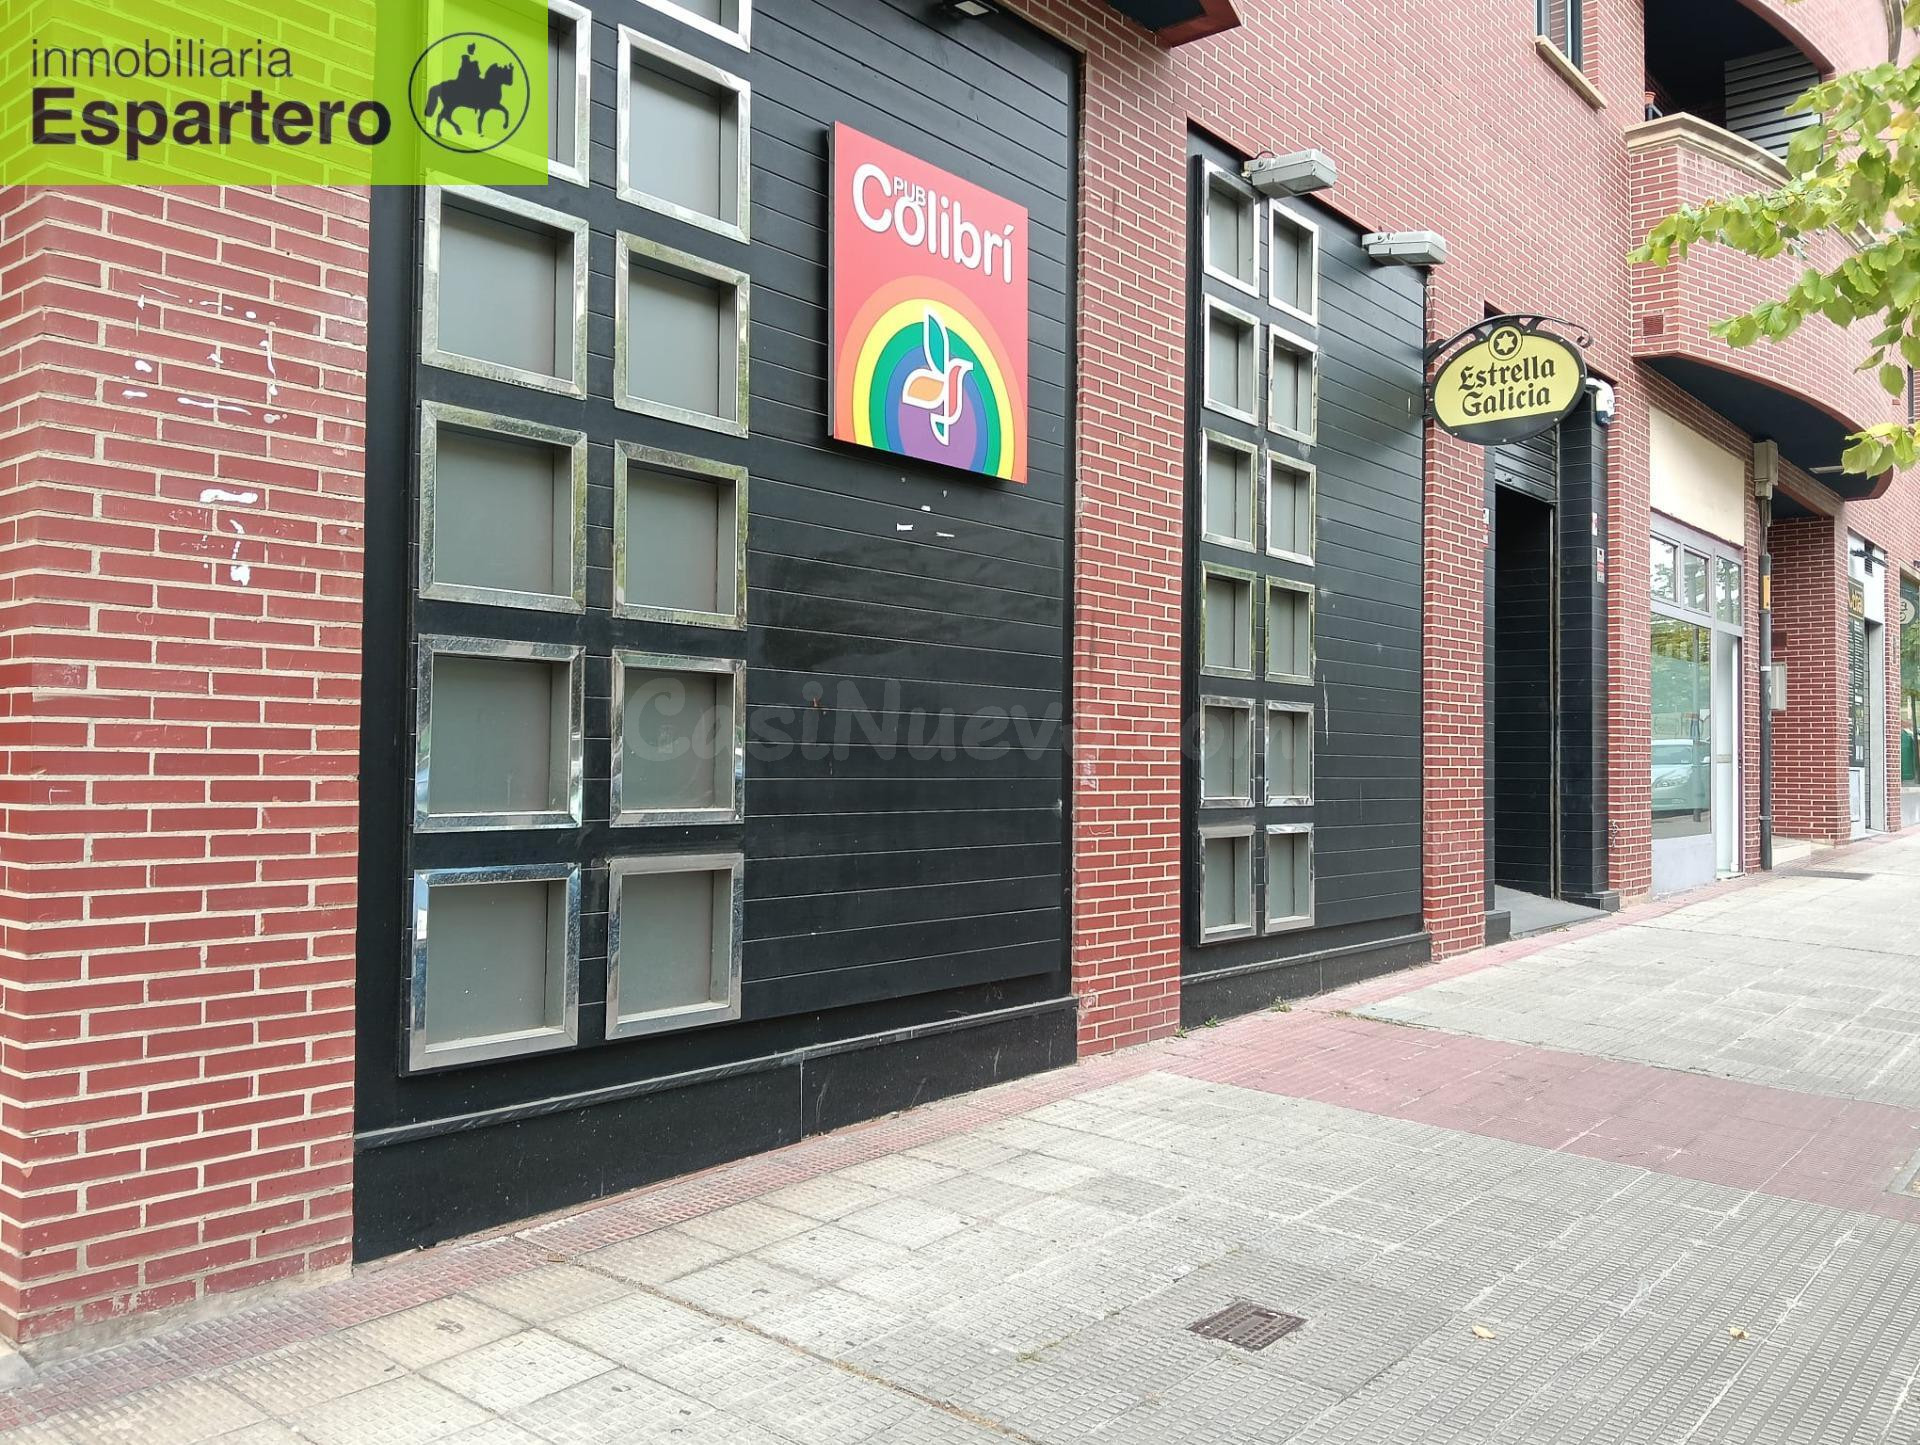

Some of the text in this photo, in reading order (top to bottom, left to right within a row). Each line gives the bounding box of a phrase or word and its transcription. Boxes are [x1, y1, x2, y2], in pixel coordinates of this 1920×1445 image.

[892, 175, 926, 208] PUB
[852, 163, 1013, 284] Colibrí
[1458, 355, 1557, 391] Estrella
[1462, 383, 1551, 417] Galicia
